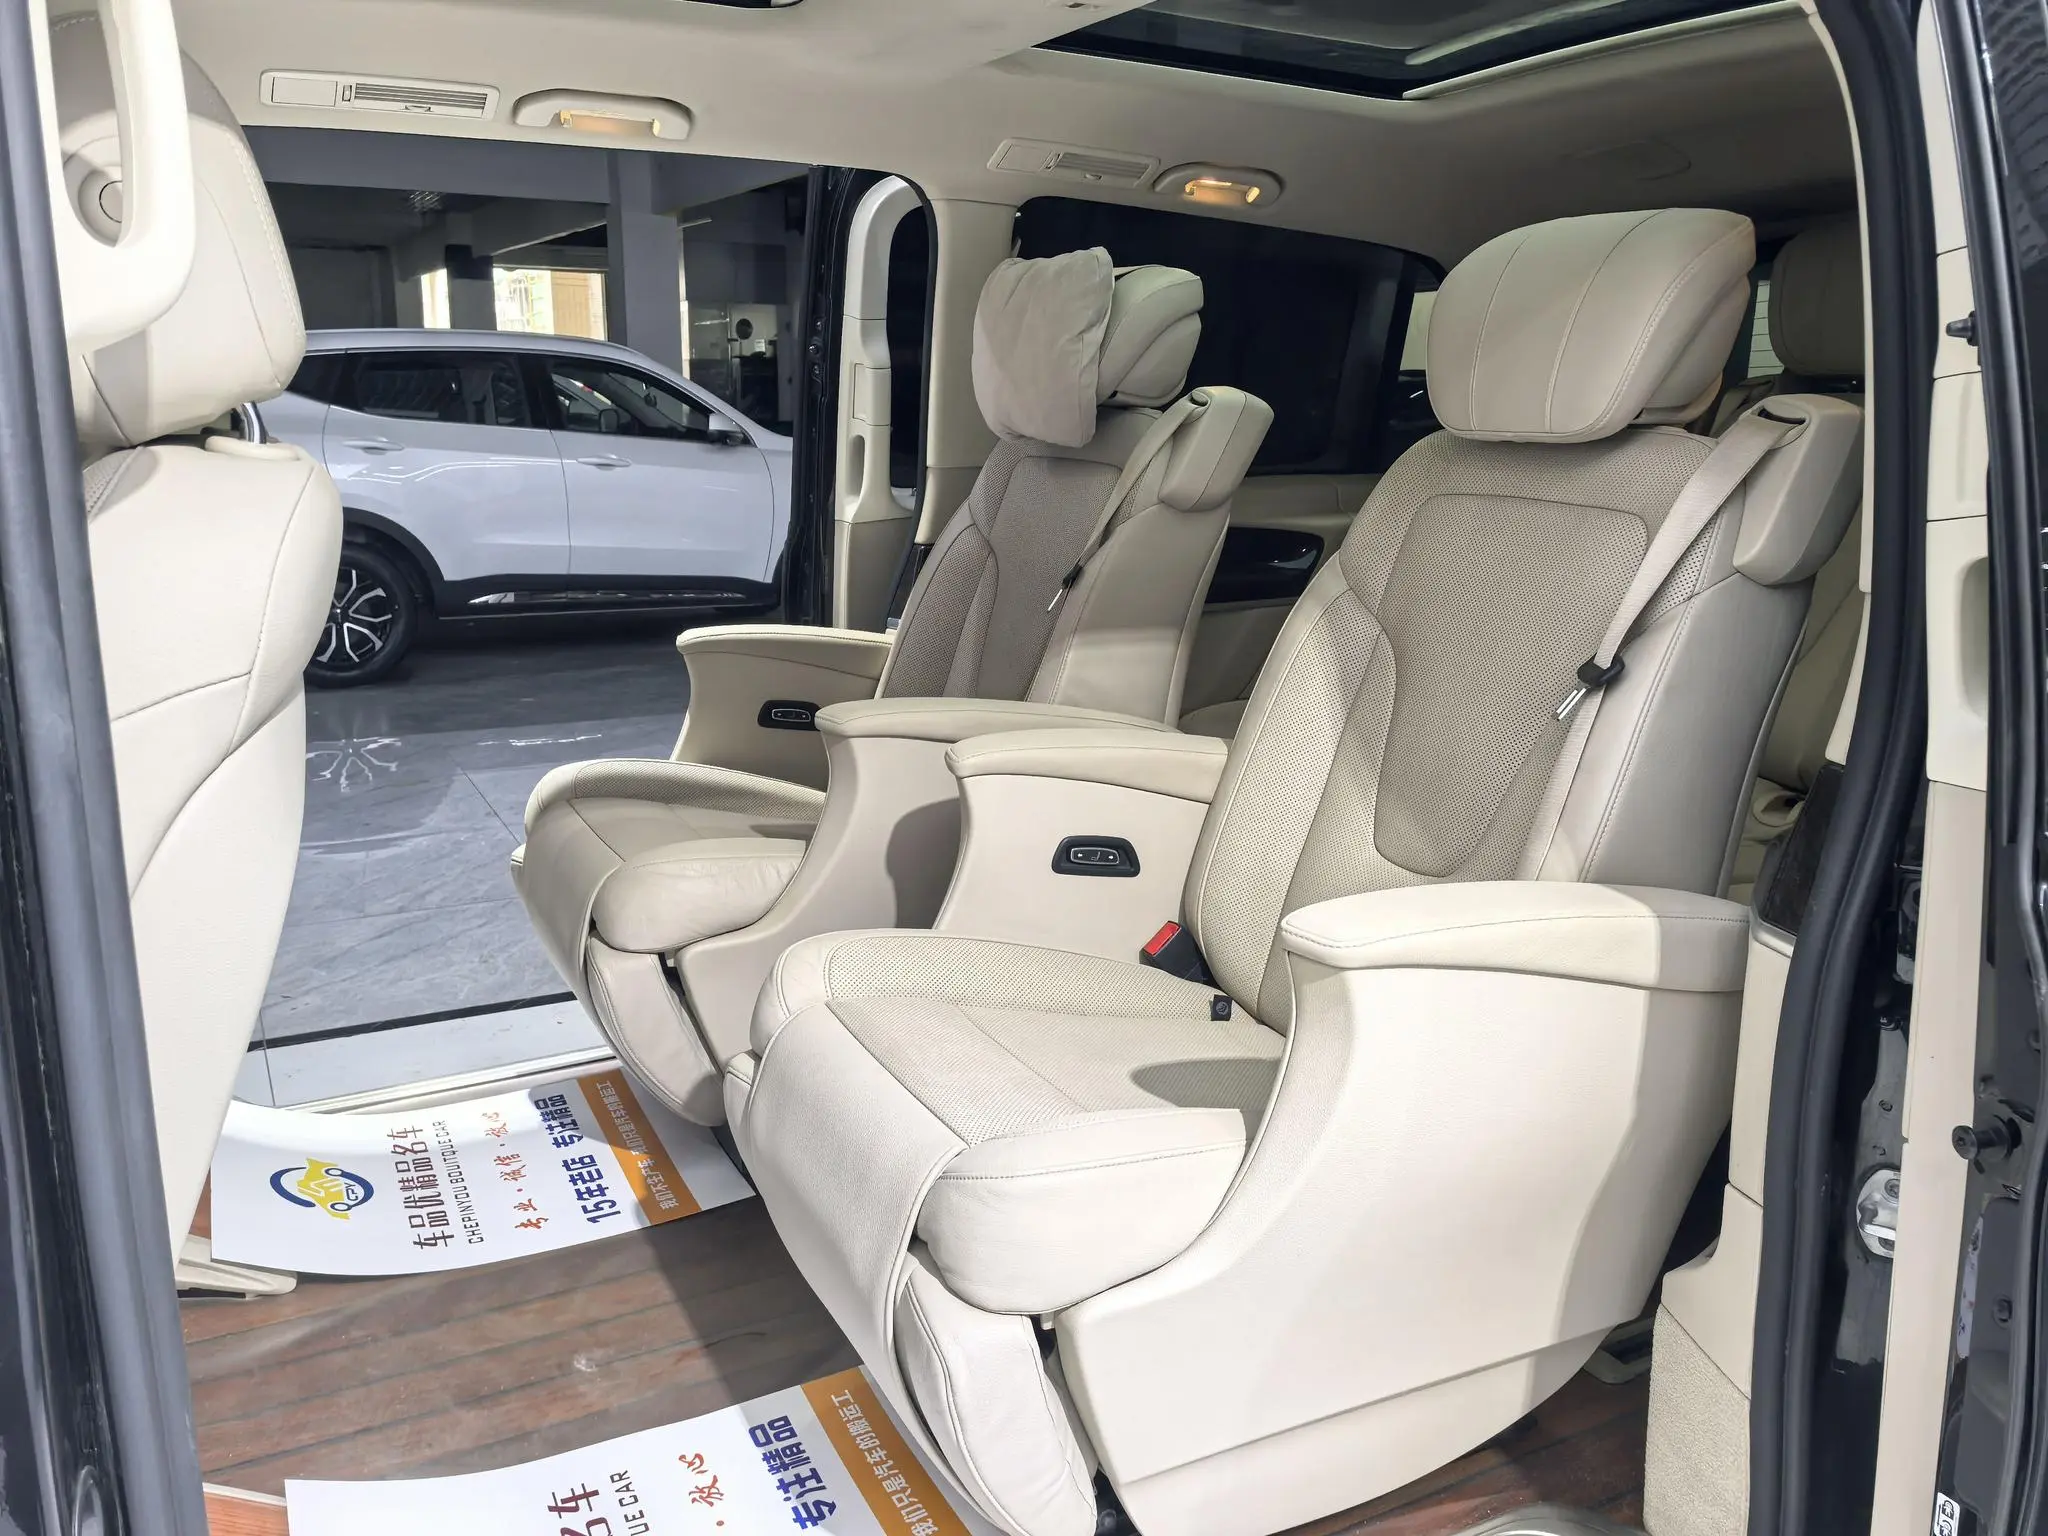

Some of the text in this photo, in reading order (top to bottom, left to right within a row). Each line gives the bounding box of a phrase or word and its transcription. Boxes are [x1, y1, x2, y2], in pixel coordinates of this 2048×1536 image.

[432, 1120, 450, 1138] CAR
[534, 1094, 622, 1224] 15年老店 专注精品
[386, 1125, 455, 1250] 车品优精品名车
[452, 1185, 485, 1244] CHEPINYOU
[637, 1158, 680, 1210] 我们不生产车
[609, 1470, 639, 1507] CAR
[748, 1415, 837, 1530] 专注精品
[830, 1389, 940, 1536] 我们只是汽车的搬运工
